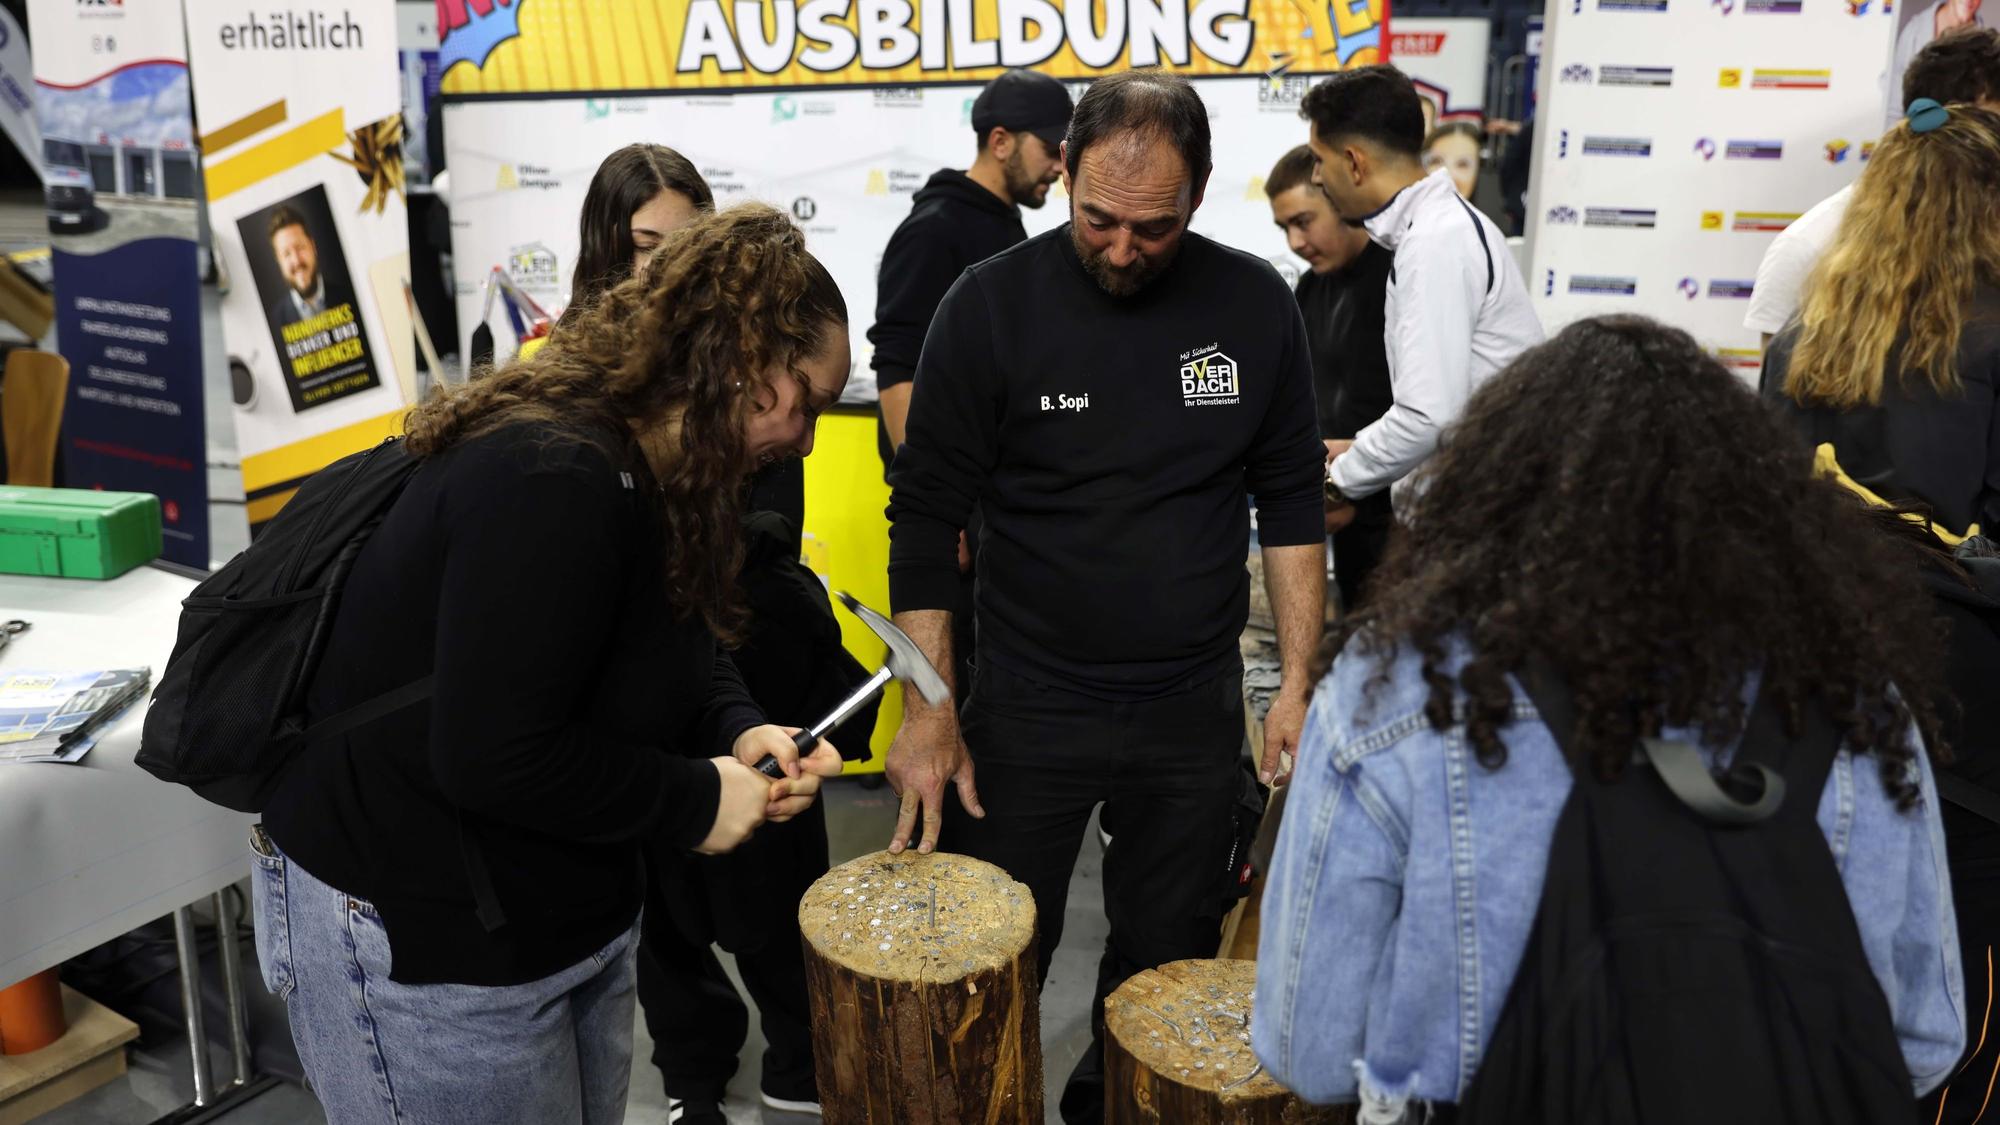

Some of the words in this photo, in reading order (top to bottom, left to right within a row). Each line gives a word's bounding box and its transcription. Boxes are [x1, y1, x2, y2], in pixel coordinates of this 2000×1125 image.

[219, 10, 364, 50] erhältlich
[676, 0, 1256, 74] AUSBILDUNG
[285, 330, 332, 360] DENKER
[331, 320, 360, 343] UND
[291, 336, 365, 379] INFLUENCER
[1180, 358, 1232, 380] OVER
[1181, 377, 1233, 395] DACH
[1040, 395, 1055, 411] B.
[1059, 393, 1089, 412] Sopi
[1184, 399, 1196, 407] Ihr
[1196, 397, 1240, 406] Dienstleister!
